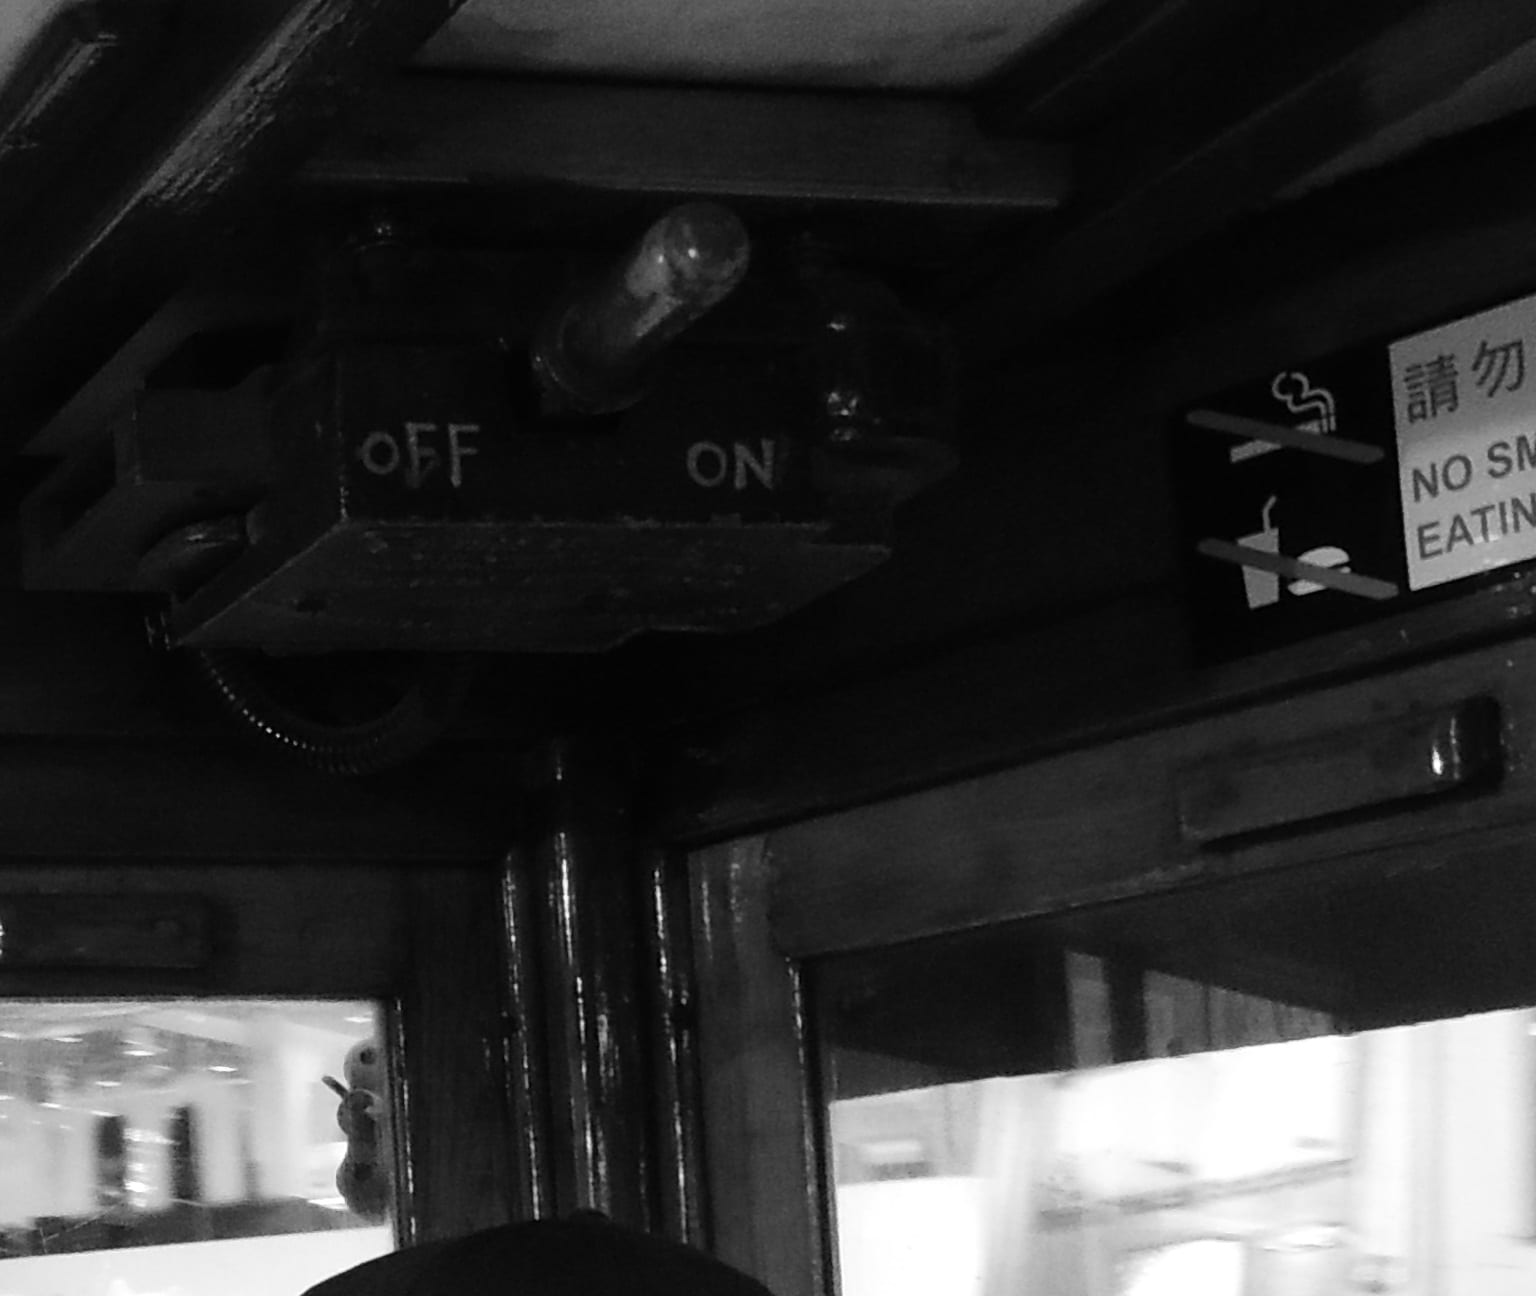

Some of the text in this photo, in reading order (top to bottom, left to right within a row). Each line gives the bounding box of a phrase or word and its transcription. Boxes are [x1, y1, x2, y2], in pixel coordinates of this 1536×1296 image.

[1403, 338, 1526, 424] 請勿
[360, 420, 481, 490] OFF
[685, 436, 778, 491] ON
[1412, 453, 1473, 503] NO
